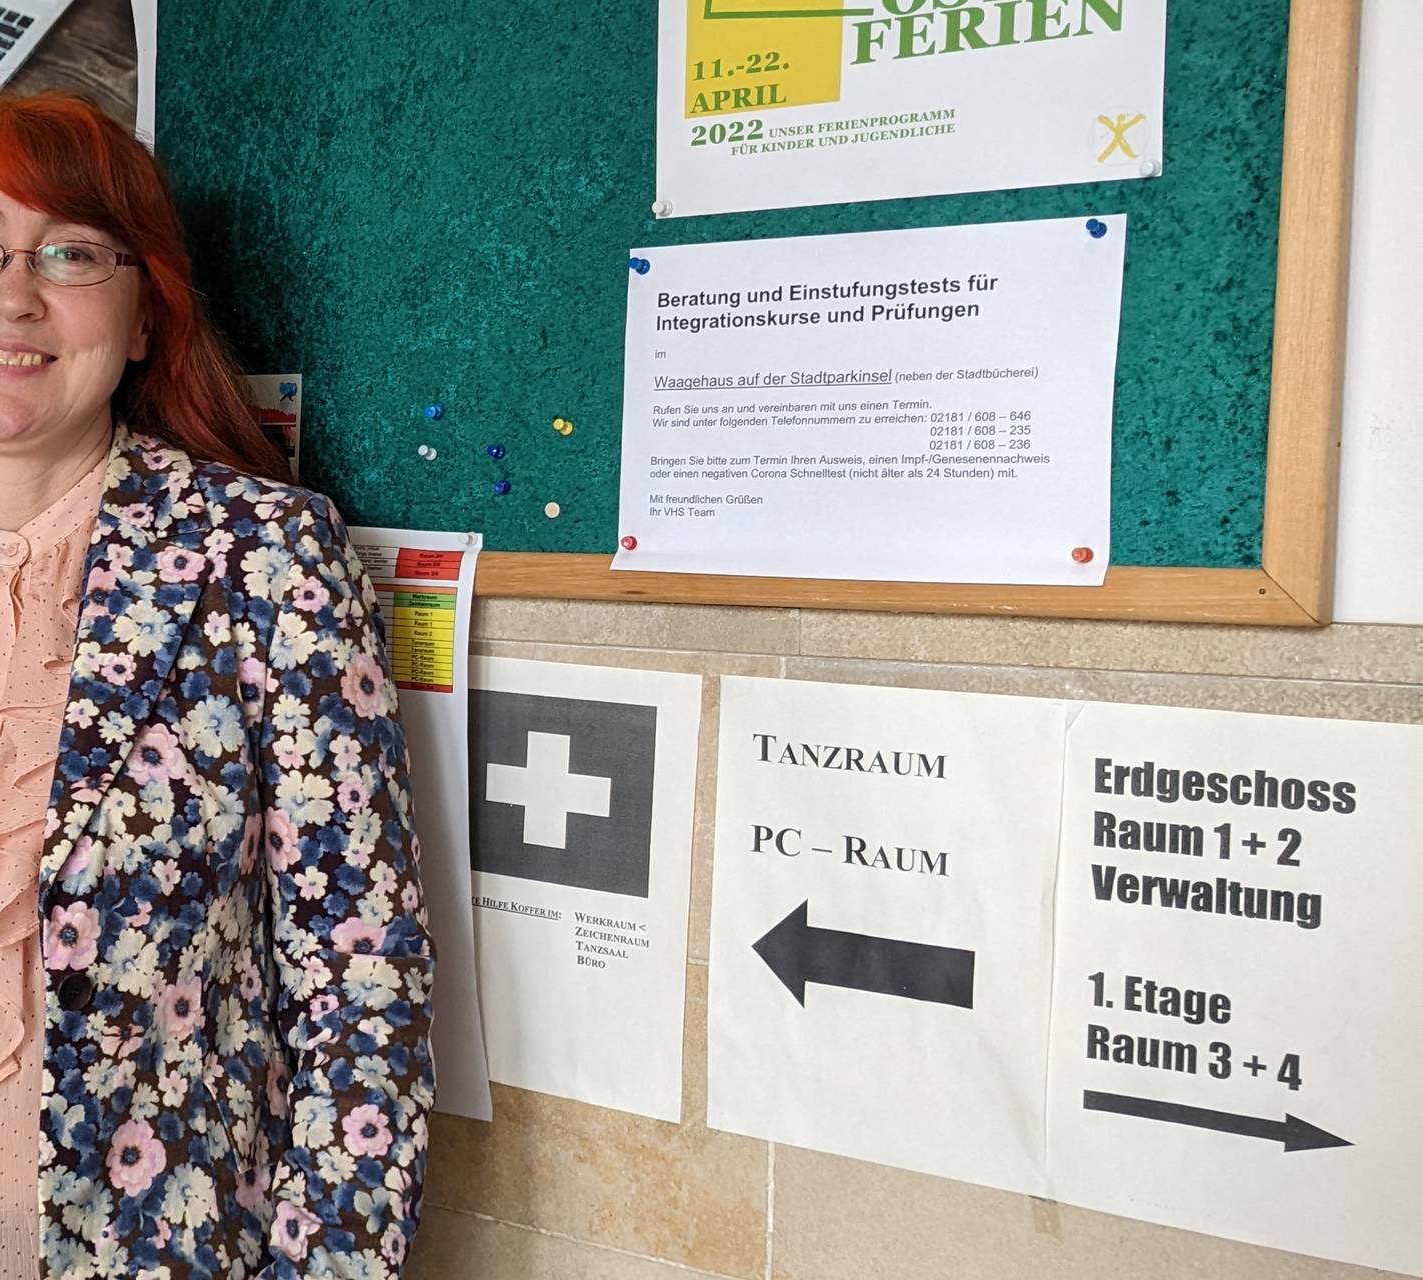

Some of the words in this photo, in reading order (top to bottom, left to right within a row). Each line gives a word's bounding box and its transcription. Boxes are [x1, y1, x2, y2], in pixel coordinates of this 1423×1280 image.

[851, 0, 1123, 65] FERIEN
[693, 52, 790, 80] 11.-22.
[689, 84, 787, 113] APRIL
[691, 119, 763, 146] 2022
[769, 125, 814, 138] UNSER
[818, 109, 956, 133] FERIENPROGRAMM
[731, 143, 758, 156] FÜR
[762, 139, 815, 152] KINDER
[819, 136, 848, 146] UND
[851, 124, 956, 144] JUGENDLICHE
[658, 289, 741, 309] Beratung
[747, 286, 783, 304] und
[789, 277, 961, 302] Einstufungstests
[968, 274, 998, 292] für
[656, 312, 820, 333] Integrationskurse
[827, 306, 865, 324] und
[871, 302, 980, 322] Prüfungen
[655, 350, 666, 360] im
[654, 375, 734, 390] Waagehaus
[738, 373, 760, 386] auf
[763, 372, 786, 385] der
[790, 368, 892, 385] Stadtparkinsel
[895, 371, 932, 383] (neben
[936, 370, 953, 380] der
[957, 367, 1039, 380] Stadtbücherei)
[653, 405, 681, 414] Rufen
[684, 405, 699, 414] Sie
[702, 405, 719, 413] uns
[722, 405, 734, 413] an
[737, 403, 755, 413] und
[759, 403, 817, 412] vereinbaren
[820, 403, 835, 411] mit
[838, 402, 857, 411] uns
[860, 401, 889, 410] einen
[892, 400, 932, 409] Termin.
[653, 418, 669, 427] Wir
[671, 418, 690, 427] sind
[720, 417, 768, 428] folgenden
[771, 415, 855, 425] Telefonnummern
[859, 415, 871, 424] zu
[874, 413, 927, 423] erreichen:
[930, 413, 964, 422] 02181
[967, 412, 972, 422] /
[975, 412, 995, 421] 608
[1010, 411, 1031, 421] 646
[930, 427, 964, 436] 02181
[967, 426, 972, 436] /
[974, 426, 995, 436] 608
[1010, 425, 1031, 435] 235
[929, 441, 963, 450] 02181
[967, 440, 971, 450] /
[974, 440, 995, 449] 608
[1009, 439, 1031, 449] 236
[650, 456, 686, 467] Bringen
[689, 456, 704, 465] Sie
[707, 456, 727, 465] bitte
[730, 457, 750, 465] zum
[754, 456, 788, 465] Termin
[791, 455, 816, 465] Ihren
[820, 455, 865, 466] Ausweis,
[869, 456, 897, 465] einen
[901, 454, 1050, 466] Impf-/Genesenennachweis
[650, 469, 671, 478] oder
[673, 469, 699, 478] einen
[702, 469, 748, 480] negativen
[751, 469, 787, 478] Corona
[790, 468, 846, 478] Schnelltest
[849, 469, 878, 479] (nicht
[881, 469, 904, 478] älter
[908, 469, 923, 478] als
[926, 469, 940, 478] 24
[944, 468, 994, 479] Stunden)
[998, 469, 1017, 478] mit.
[650, 495, 663, 504] Mit
[666, 495, 723, 504] freundlichen
[725, 495, 763, 505] Grüßen
[650, 508, 661, 517] Ihr
[664, 508, 684, 517] VHS
[689, 508, 715, 517] Team
[753, 734, 948, 779] TANZRAUM
[1095, 757, 1356, 814] Erdgeschoss
[751, 824, 802, 857] PC
[842, 835, 951, 877] RAUM
[1094, 811, 1203, 857] Raum
[1214, 823, 1231, 860] 1
[1241, 833, 1266, 855] +
[1277, 827, 1302, 867] 2
[482, 897, 509, 910] HILFE
[511, 903, 546, 916] KOFFER
[547, 910, 562, 920] IM:
[1091, 864, 1322, 930] Verwaltung
[575, 912, 636, 932] WERKRAUM
[575, 927, 650, 948] ZEICHENRAUM
[576, 940, 629, 959] TANZSAAL
[577, 955, 606, 969] BÜRO
[1088, 971, 1113, 1008] 1.
[1124, 975, 1231, 1025] Etage
[1087, 1023, 1197, 1074] Raum
[1208, 1041, 1231, 1079] 3
[1243, 1055, 1267, 1077] +
[1277, 1053, 1302, 1091] 4
